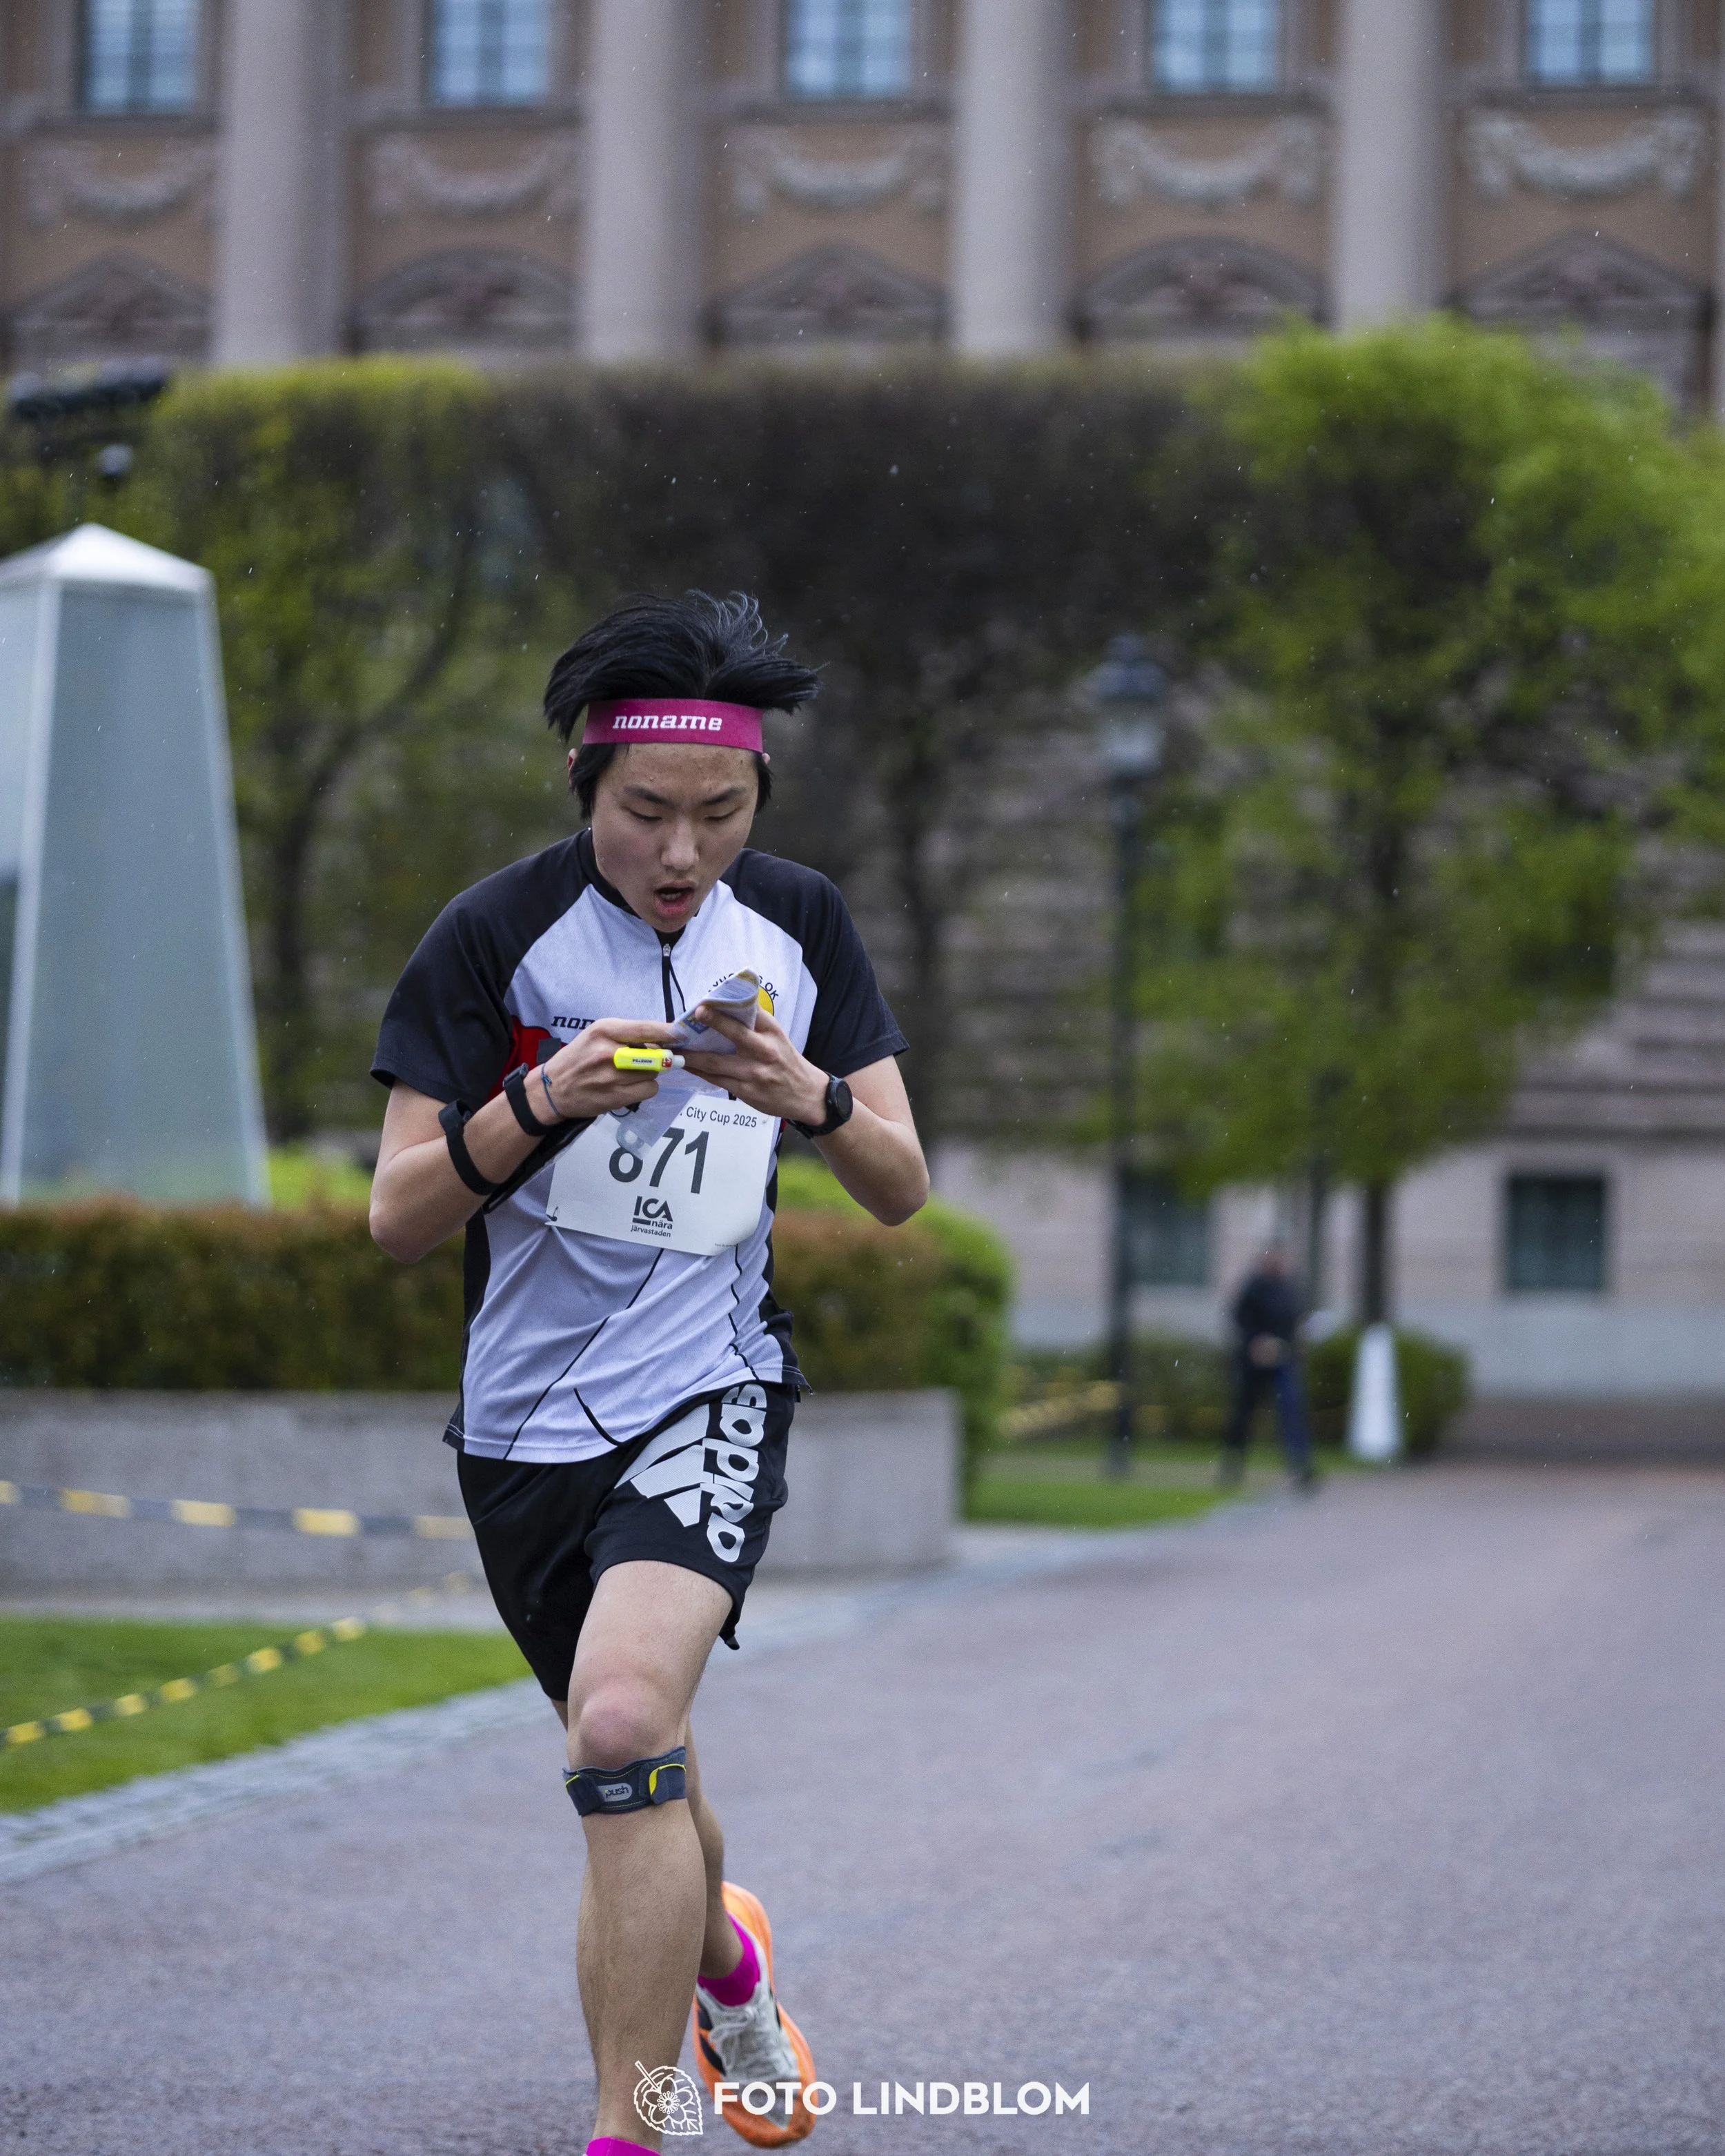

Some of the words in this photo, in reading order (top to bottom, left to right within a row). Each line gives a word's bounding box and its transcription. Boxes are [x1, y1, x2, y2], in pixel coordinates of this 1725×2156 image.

[613, 715, 722, 731] noname
[765, 982, 779, 1000] OK
[686, 1106, 707, 1122] City
[709, 1110, 730, 1126] Cup
[733, 1114, 758, 1128] 2025
[633, 1196, 673, 1222] ICA
[651, 1220, 673, 1230] nära
[700, 1383, 767, 1562] adidas
[604, 1785, 629, 1798] push
